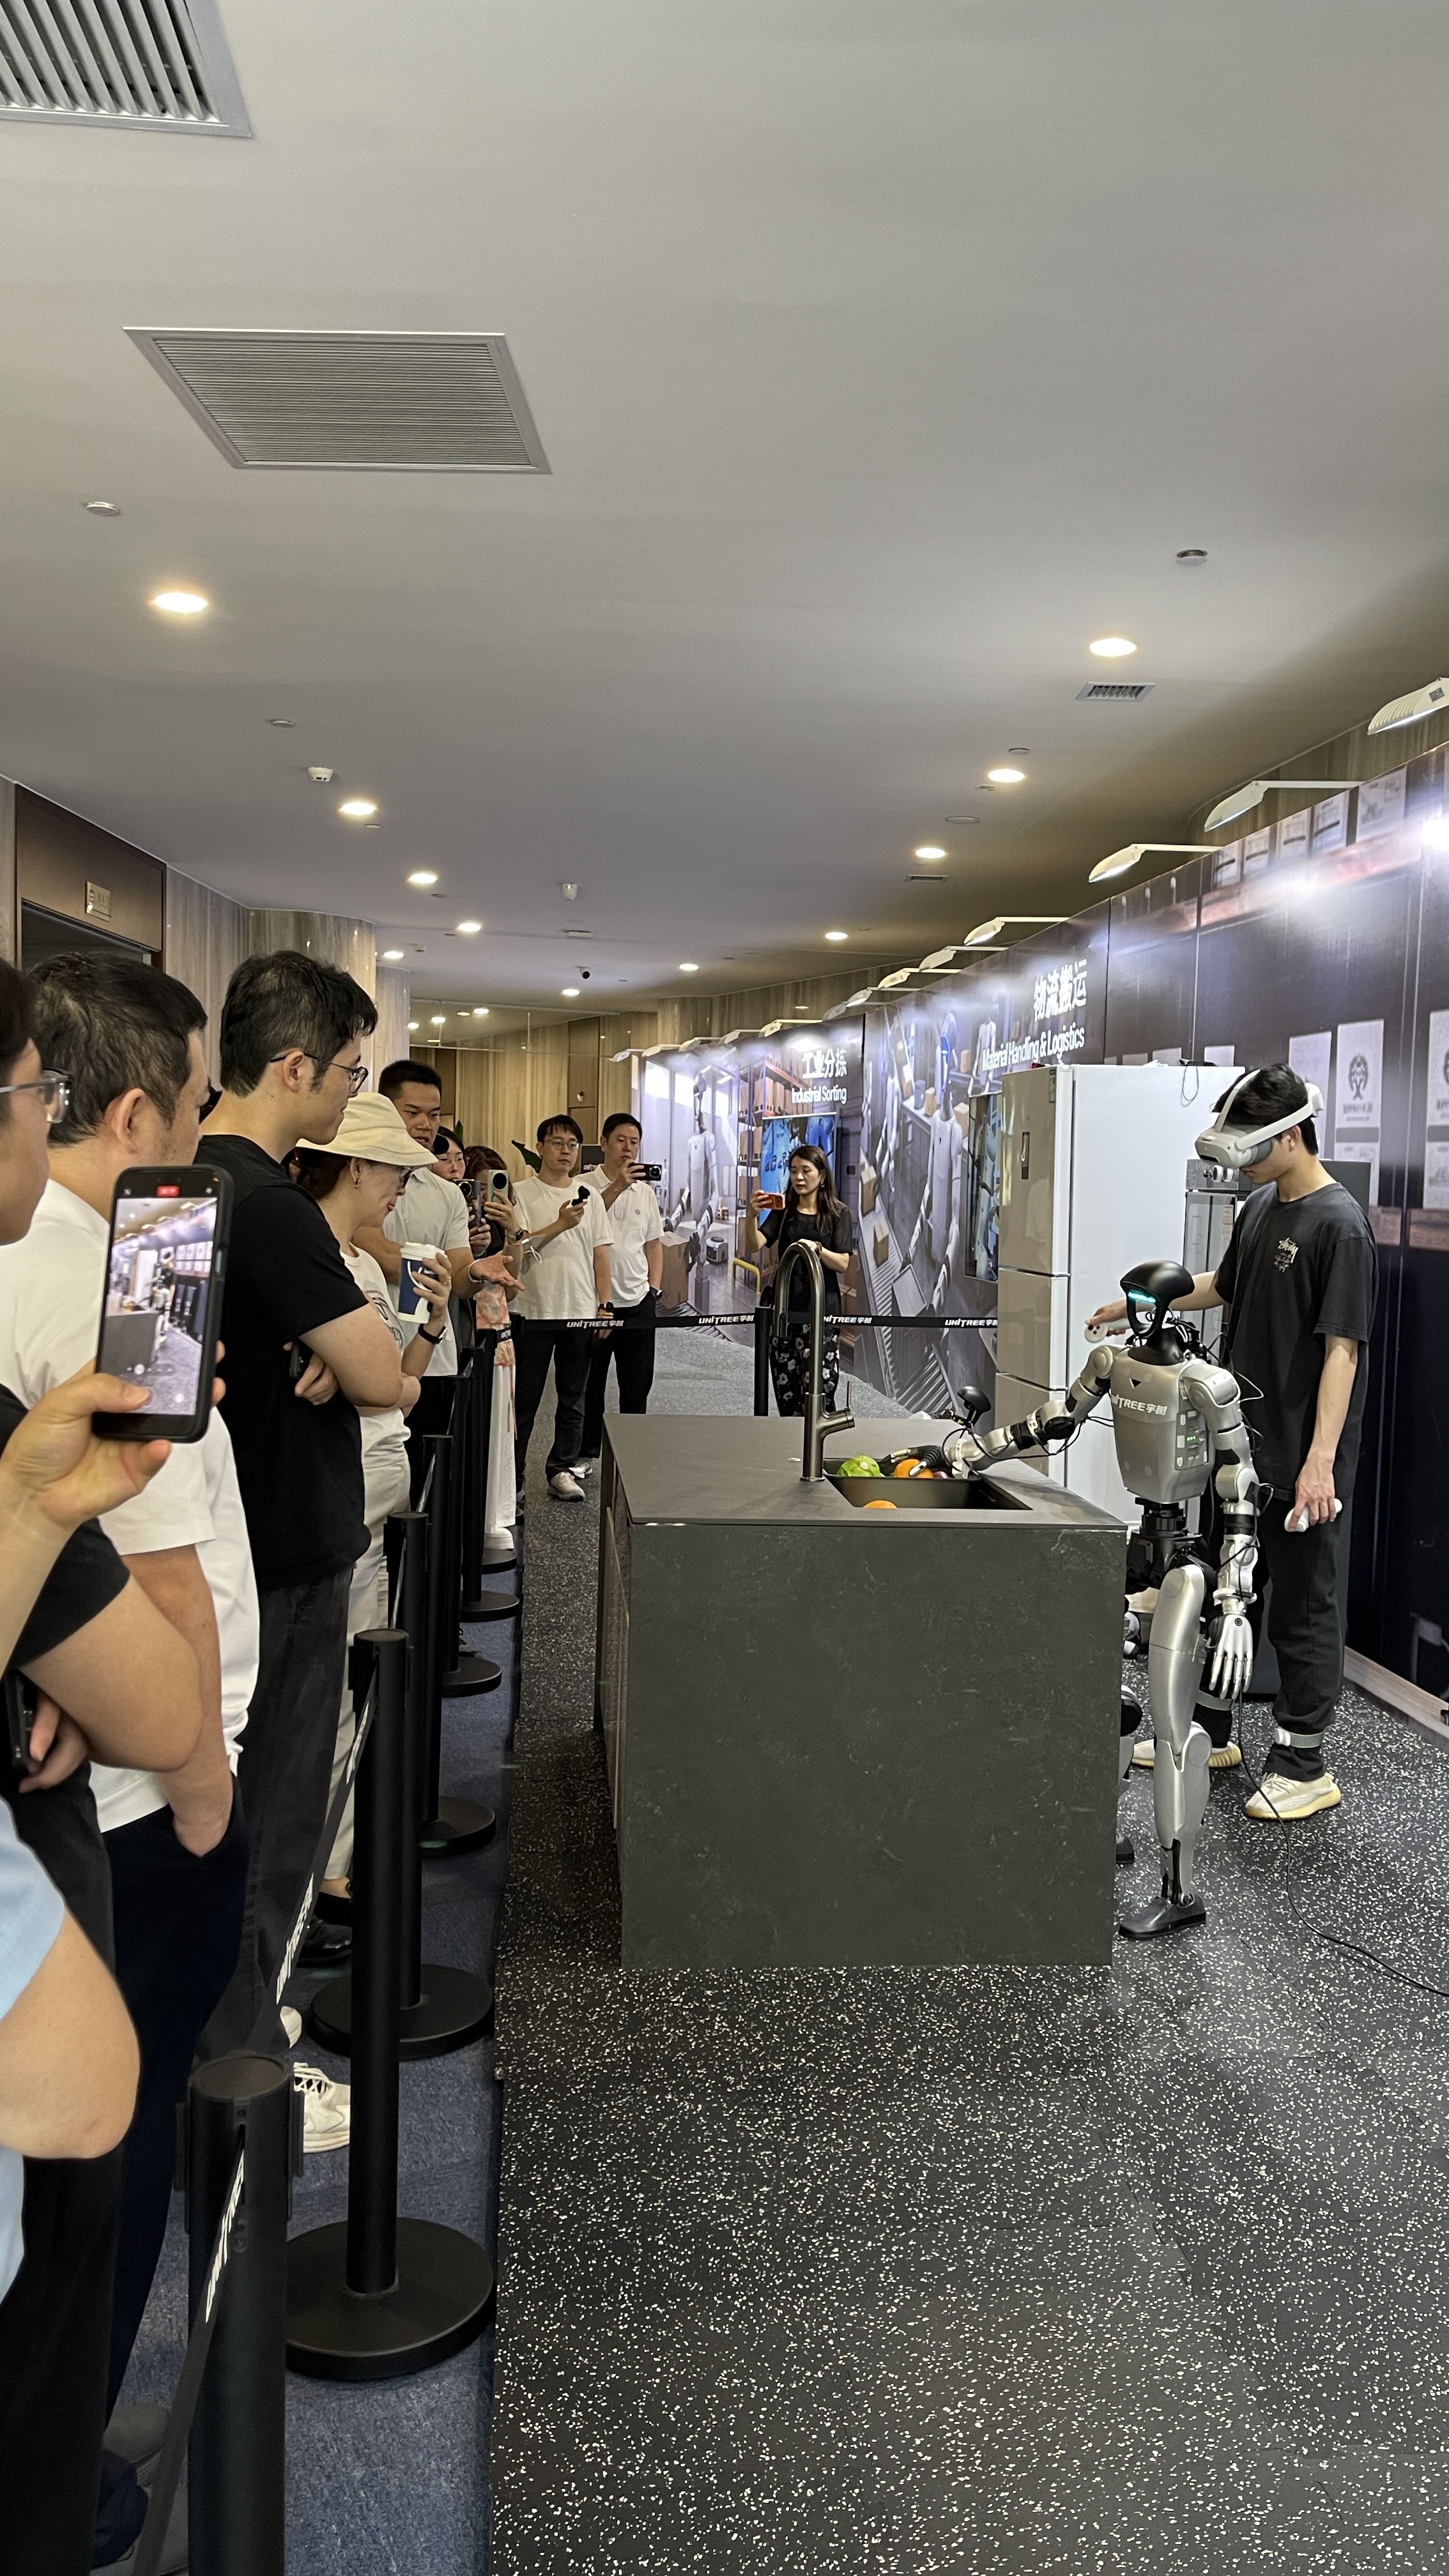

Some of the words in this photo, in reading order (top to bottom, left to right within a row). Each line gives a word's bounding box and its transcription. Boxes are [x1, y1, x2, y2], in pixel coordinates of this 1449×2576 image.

[1034, 959, 1087, 1022] 物流搬运
[802, 1048, 847, 1079] 工业分拣
[982, 1042, 1009, 1071] Material
[1009, 1035, 1039, 1064] Handling
[1039, 1031, 1047, 1057] &
[1048, 1022, 1085, 1062] Logistics
[792, 1085, 821, 1103] Industrial
[822, 1084, 847, 1104] Sorting
